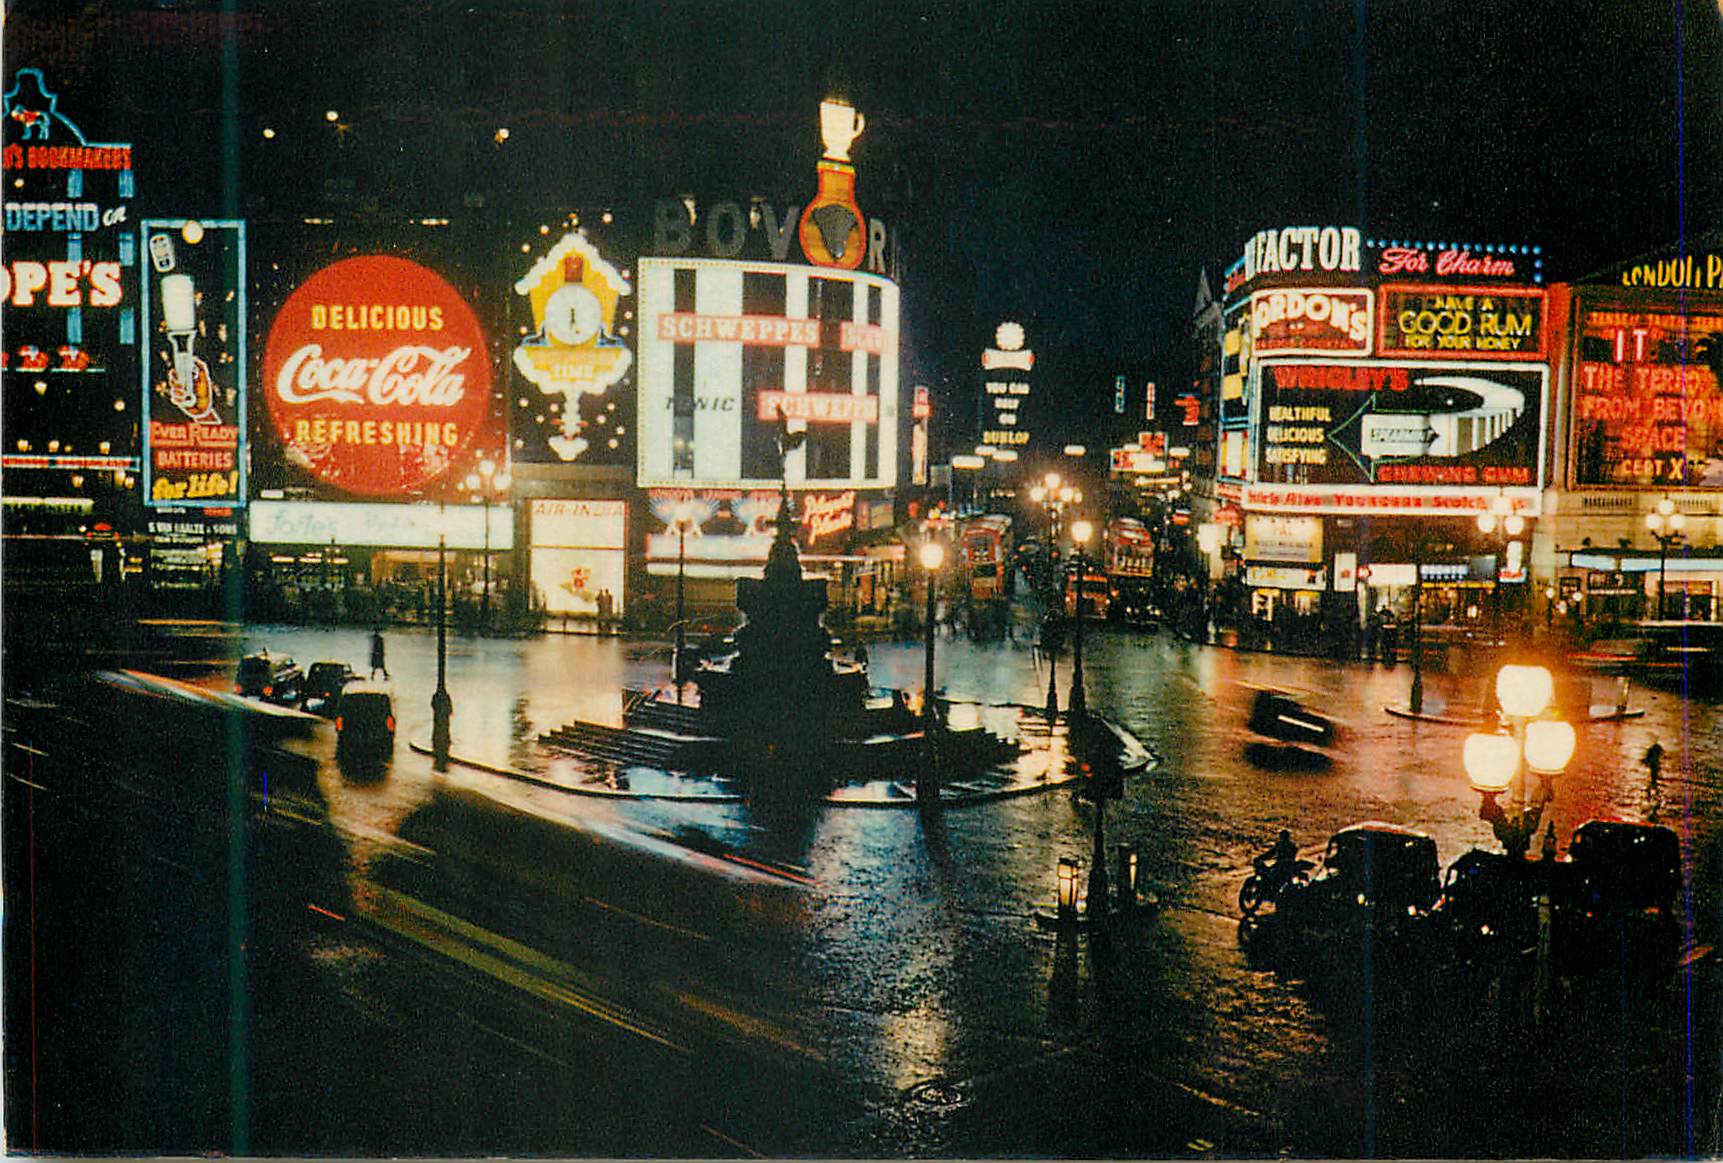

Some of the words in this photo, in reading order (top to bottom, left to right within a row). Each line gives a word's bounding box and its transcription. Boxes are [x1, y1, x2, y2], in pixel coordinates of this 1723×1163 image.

[5, 202, 99, 231] DEPEND
[1256, 226, 1361, 273] FACTOR
[1379, 247, 1429, 274] For
[1436, 248, 1515, 276] Charm
[311, 304, 445, 331] DELICIOUS
[1399, 311, 1471, 334] GOOD
[1480, 313, 1532, 336] RUM
[661, 317, 819, 345] SCHWEPPES
[1476, 337, 1521, 350] MONEY
[277, 343, 472, 407] Coca-Cola
[1582, 364, 1624, 392] THE
[664, 396, 735, 412] TNIC
[187, 422, 238, 447] READY
[294, 420, 459, 446] REFRESHING
[983, 431, 1030, 444] DUNLOP
[156, 450, 234, 470] BATTERIES
[1668, 458, 1683, 480] X
[1482, 466, 1531, 483] GUM
[152, 476, 187, 500] for
